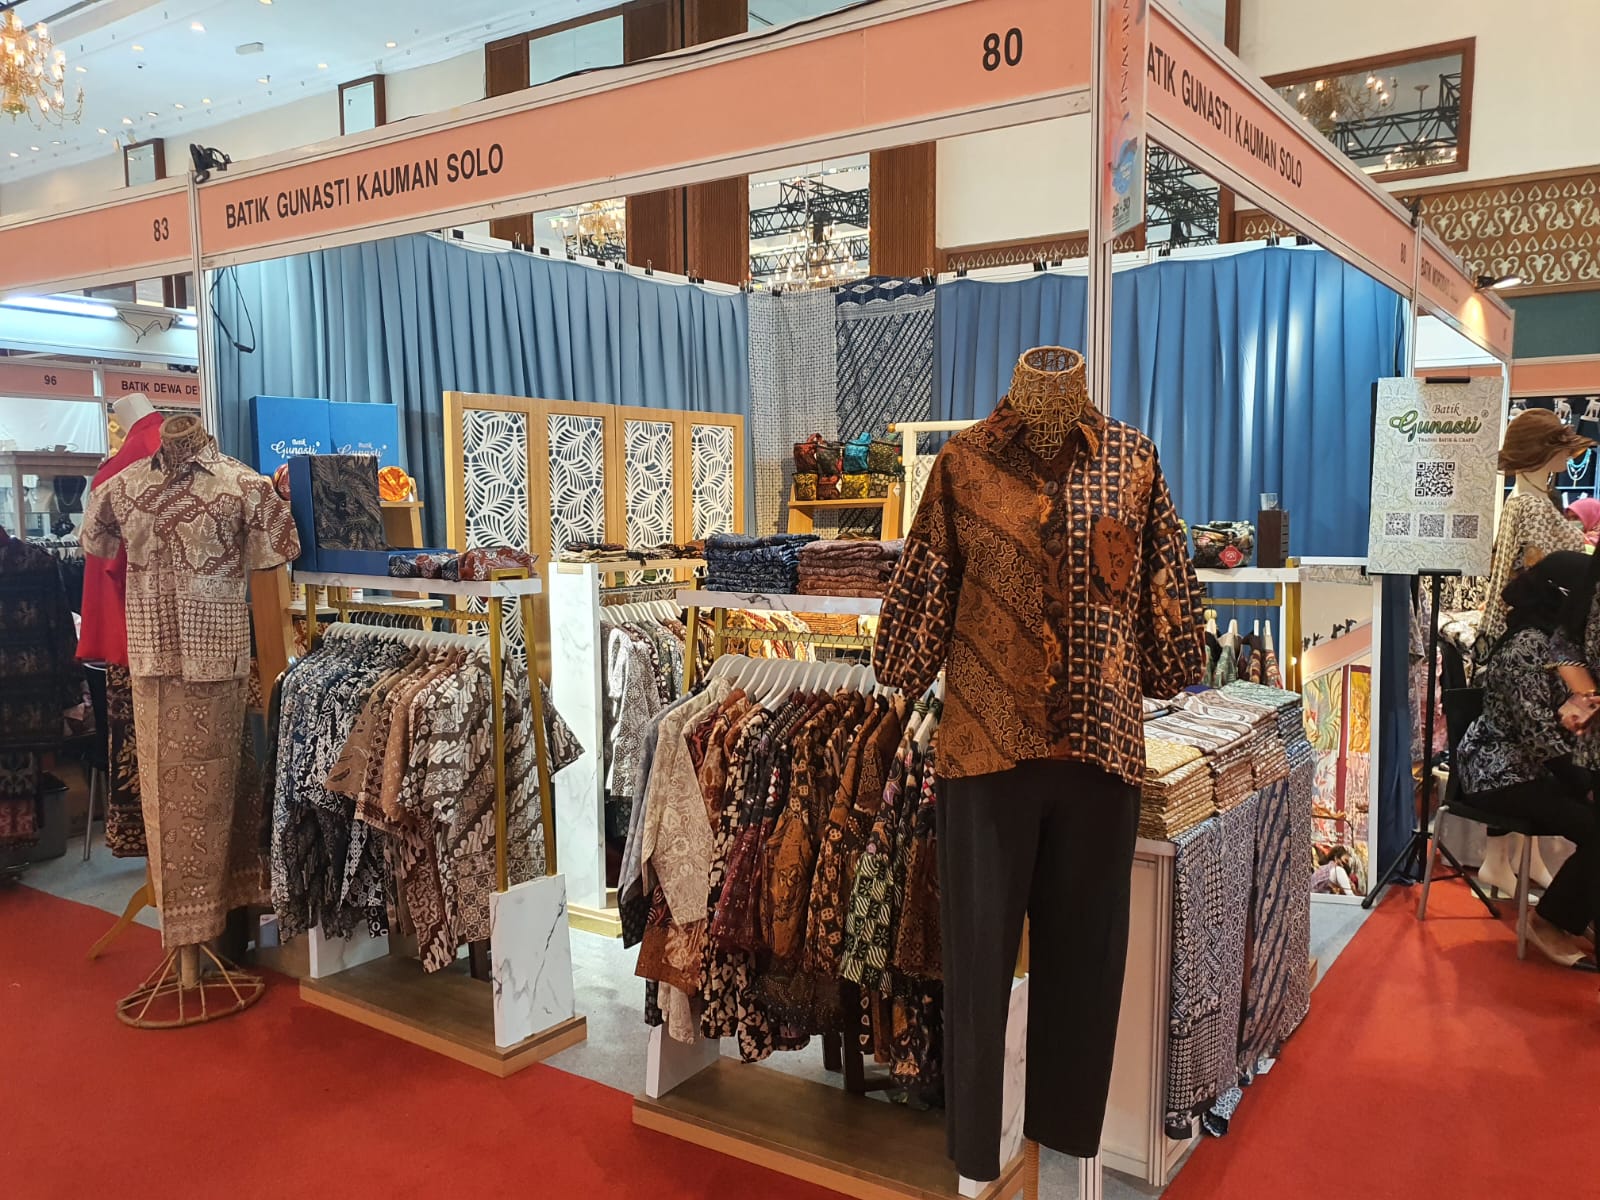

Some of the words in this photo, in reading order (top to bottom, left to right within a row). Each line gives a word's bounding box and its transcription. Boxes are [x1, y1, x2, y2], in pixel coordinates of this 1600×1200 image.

[982, 27, 1023, 71] 80
[1147, 42, 1176, 97] ATIK
[1181, 69, 1232, 138] GUNASTI
[1235, 112, 1277, 170] KAUMAN
[1279, 147, 1302, 188] SOLO
[226, 196, 270, 229] BATIK
[277, 178, 350, 218] GUNASTI
[356, 158, 438, 202] KAUMAN
[447, 143, 503, 182] SOLO
[153, 217, 169, 242] 83
[44, 375, 57, 386] 96
[121, 380, 150, 392] BATIK
[154, 383, 182, 395] DEWA
[185, 385, 200, 396] DE
[1432, 402, 1461, 417] Batik
[1389, 410, 1482, 442] Gunasti
